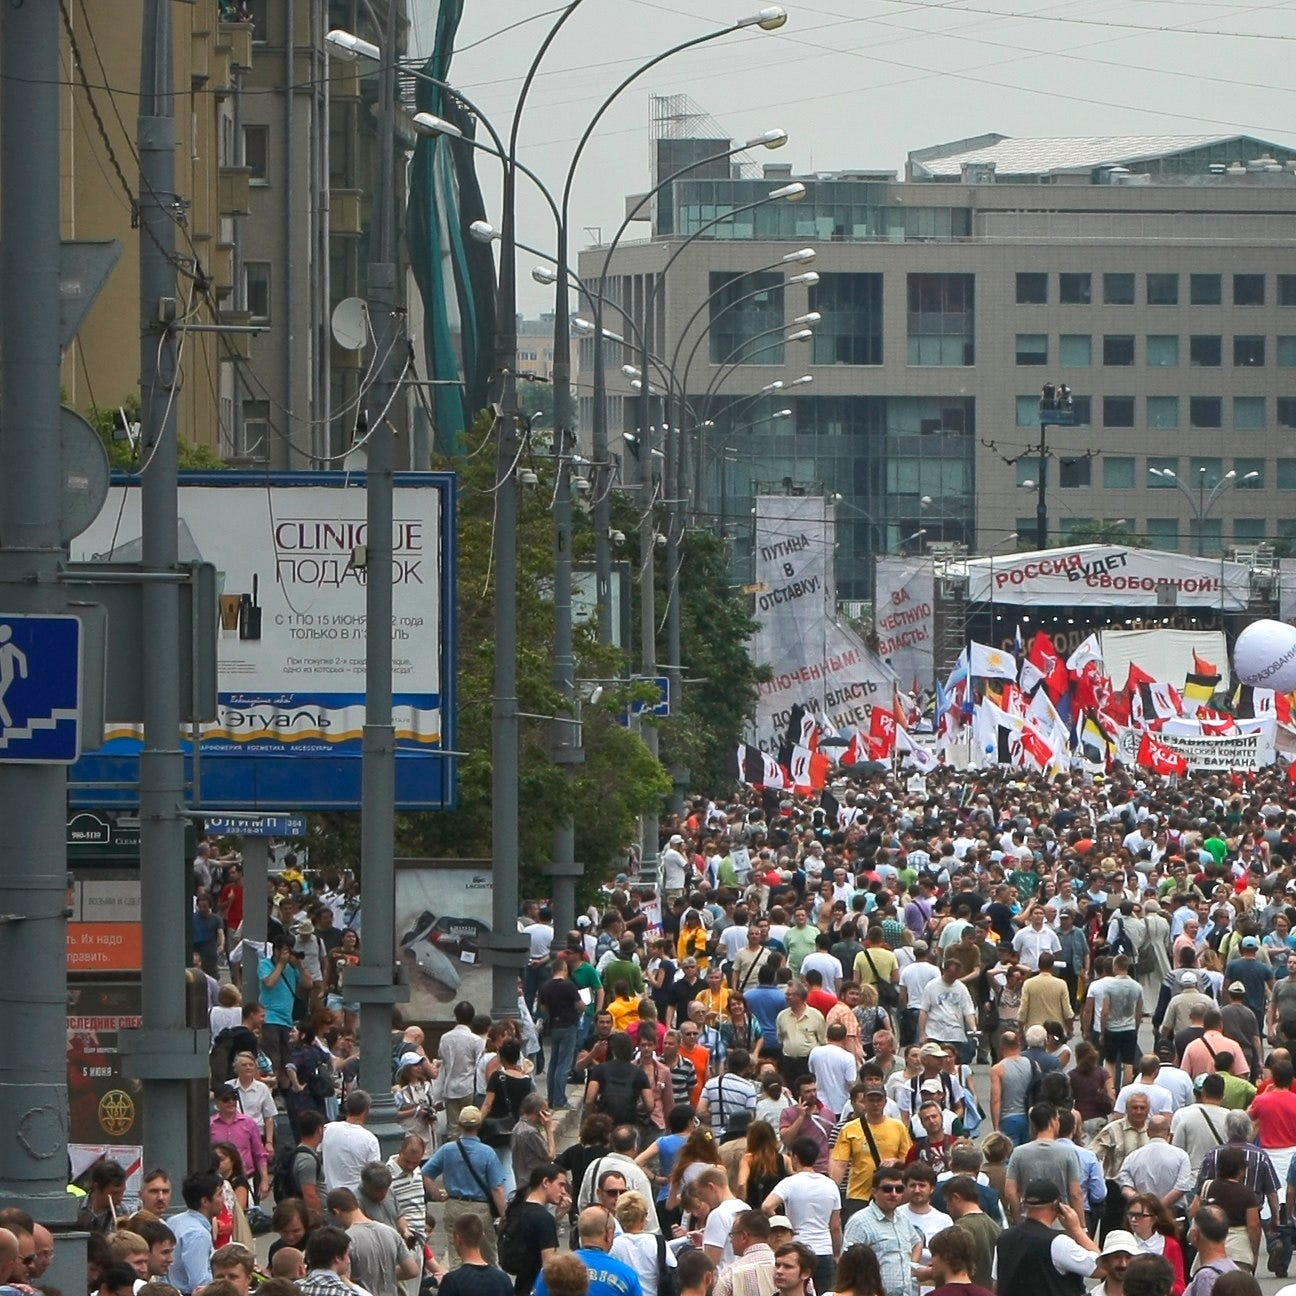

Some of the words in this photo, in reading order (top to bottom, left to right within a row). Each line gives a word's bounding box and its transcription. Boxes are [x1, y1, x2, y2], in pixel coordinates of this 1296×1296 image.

[761, 533, 810, 562] ПУТИНА
[995, 554, 1082, 589] РОССИЯ
[1066, 552, 1128, 582] БУДЕТ
[759, 575, 822, 611] ОТСТАВКУ!
[891, 587, 911, 606] ЗА
[296, 615, 314, 626] ПО
[318, 615, 329, 625] 15
[880, 603, 931, 631] ЧЕСТНУЮ
[290, 629, 338, 640] ТОЛЬКО
[341, 629, 350, 640] В
[878, 625, 929, 655] ВЛАСТЬ!
[825, 680, 878, 708] ВЛАСТЬ
[97, 935, 123, 946] надо
